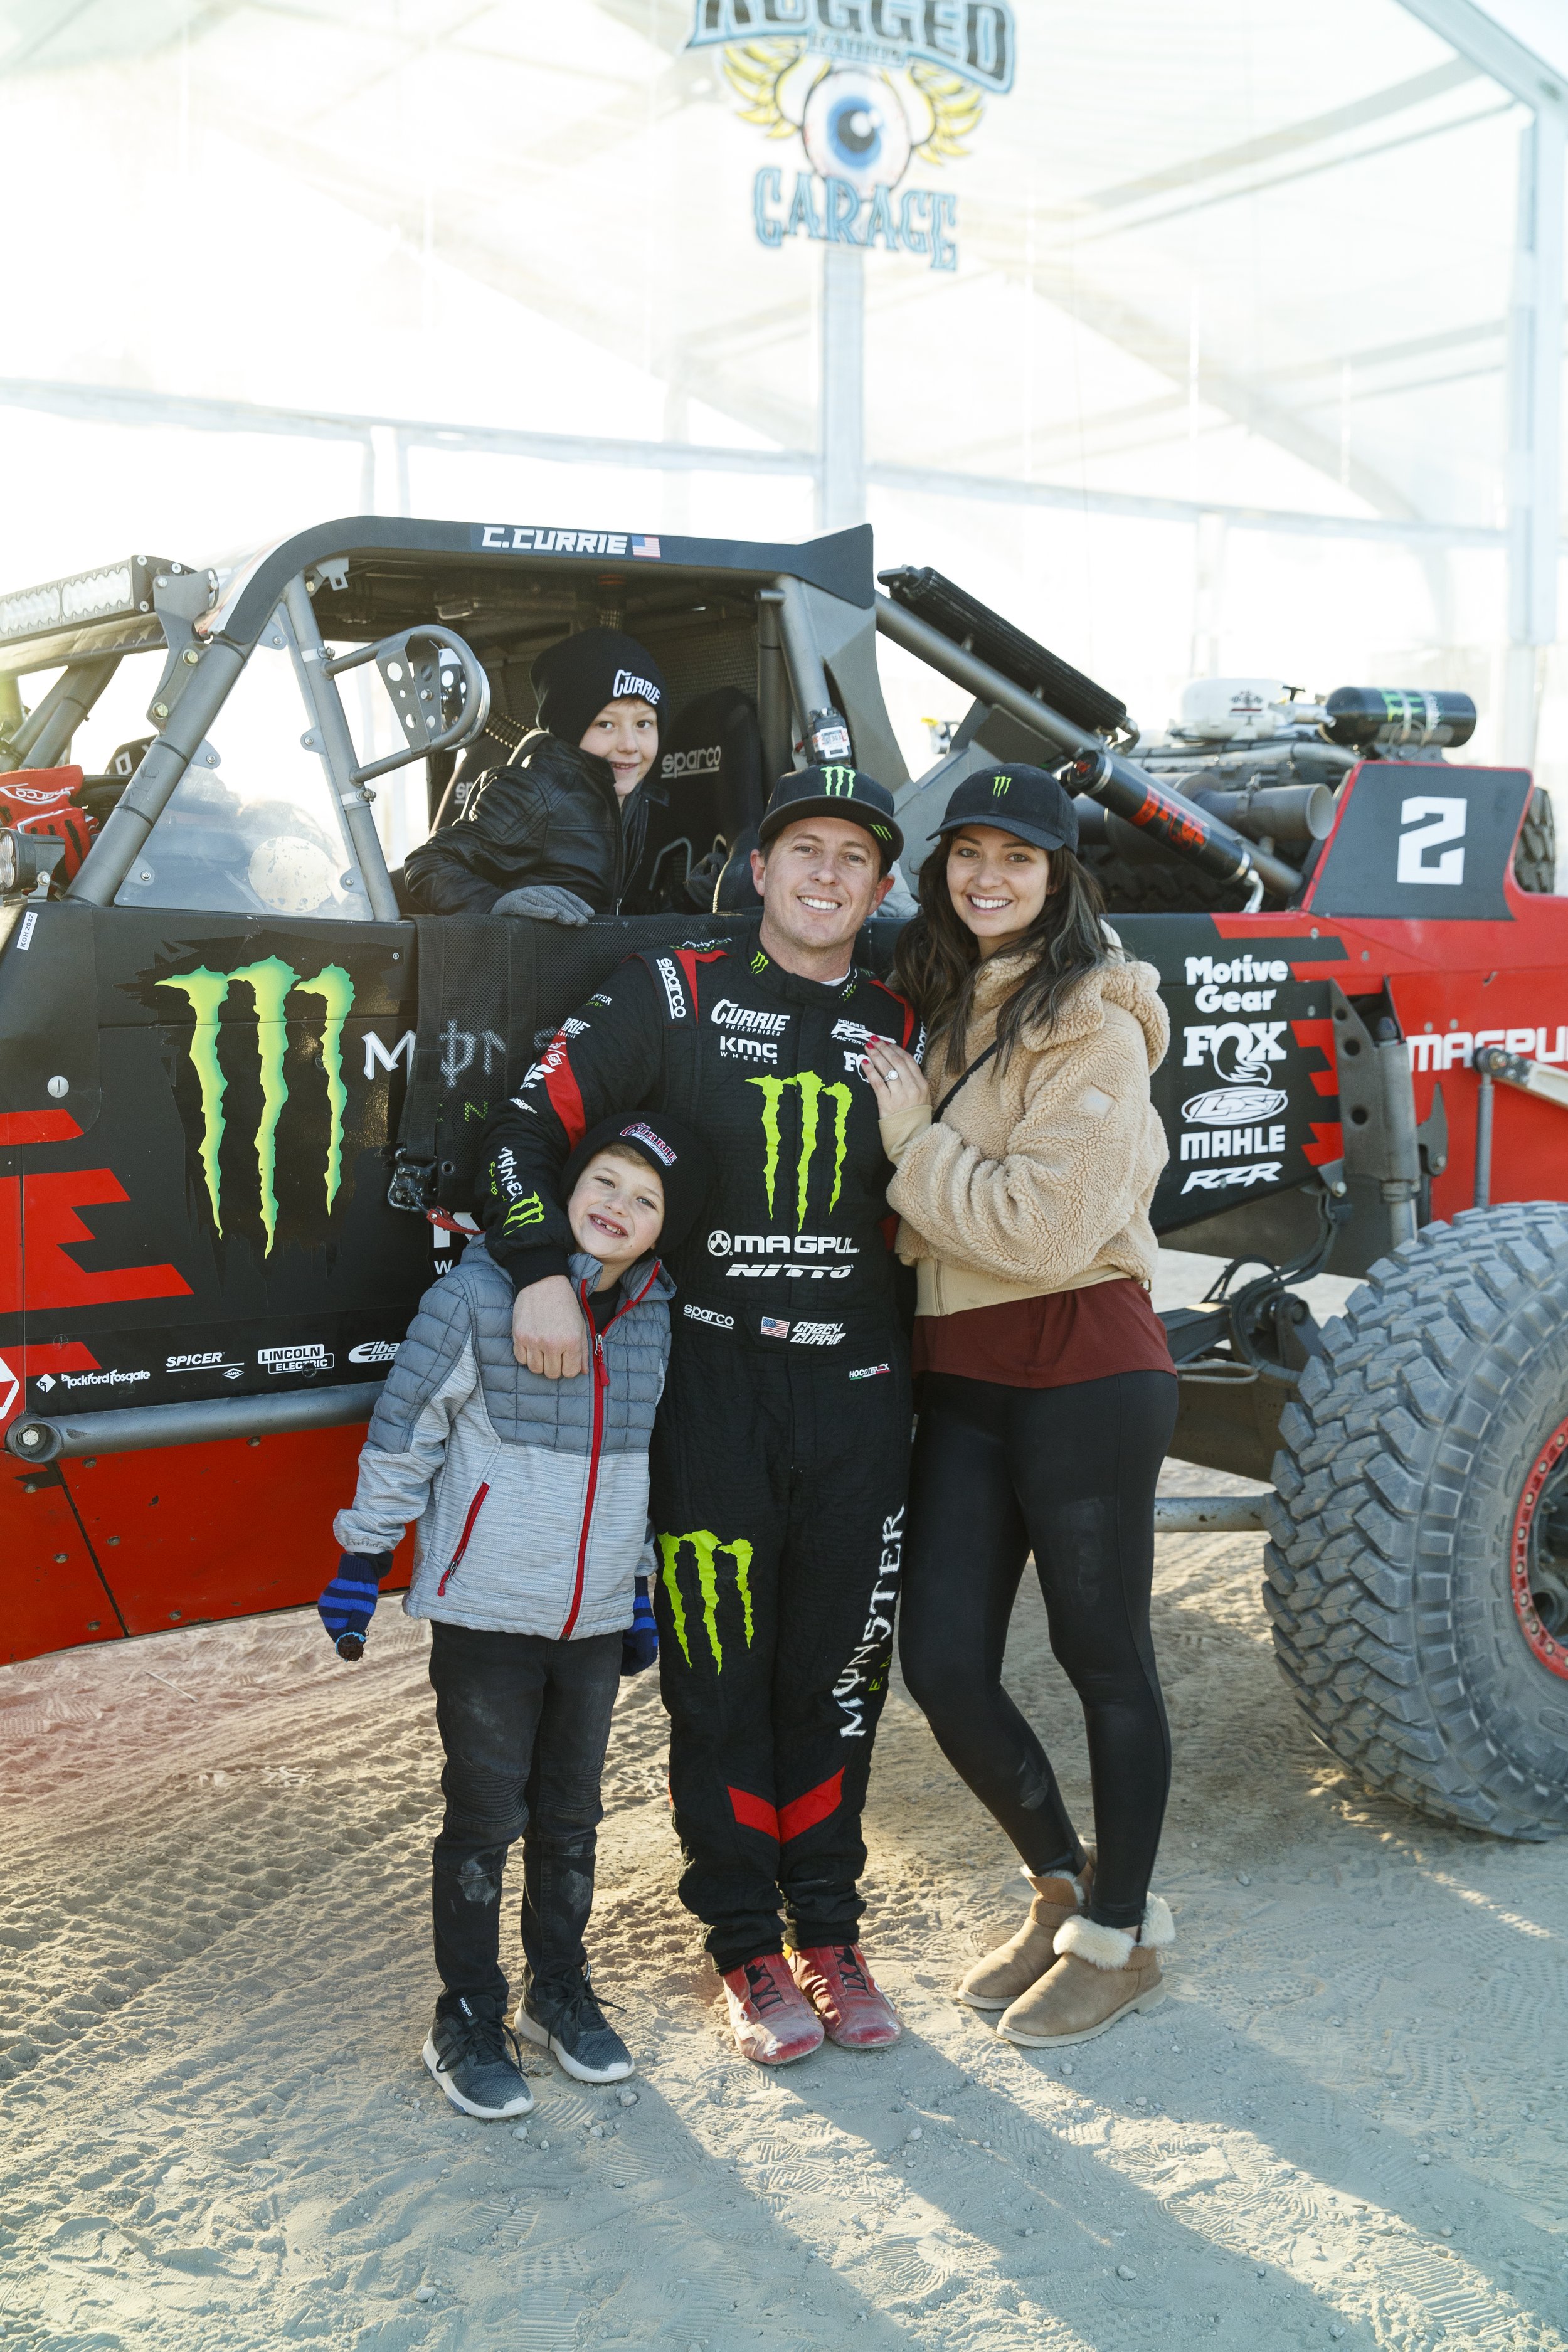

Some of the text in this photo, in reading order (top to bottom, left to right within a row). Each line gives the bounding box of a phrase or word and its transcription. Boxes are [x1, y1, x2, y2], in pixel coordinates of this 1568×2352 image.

[613, 669, 662, 705] CURRIE
[661, 745, 721, 779] sparco
[1397, 796, 1468, 885] 2
[20, 914, 34, 948] KOH 2022
[1184, 954, 1288, 985] Motive
[657, 958, 686, 1019] sparco
[1195, 984, 1277, 1013] Gear
[711, 999, 790, 1031] CURRIE
[726, 1024, 781, 1036] ENTERPRISES
[837, 1018, 866, 1030] POLARIS
[720, 1051, 778, 1064] WHEELS
[913, 1021, 928, 1065] spar
[1183, 1021, 1288, 1086] FOX
[1406, 1025, 1568, 1073] MAGPU
[620, 1122, 677, 1163] CURRIE
[1180, 1125, 1285, 1161] MAHLE
[1180, 1162, 1283, 1195] RZR
[734, 1235, 860, 1254] MAGPUL
[726, 1264, 852, 1279] NITTO
[684, 1304, 734, 1329] sparco
[166, 1352, 223, 1367] SPICER
[262, 1347, 320, 1362] LINCOLN
[349, 1341, 400, 1363] Eiba
[61, 1369, 151, 1390] Rockford Fosgate
[832, 1504, 905, 1739] MONSTER
[460, 1997, 472, 2016] adidas
